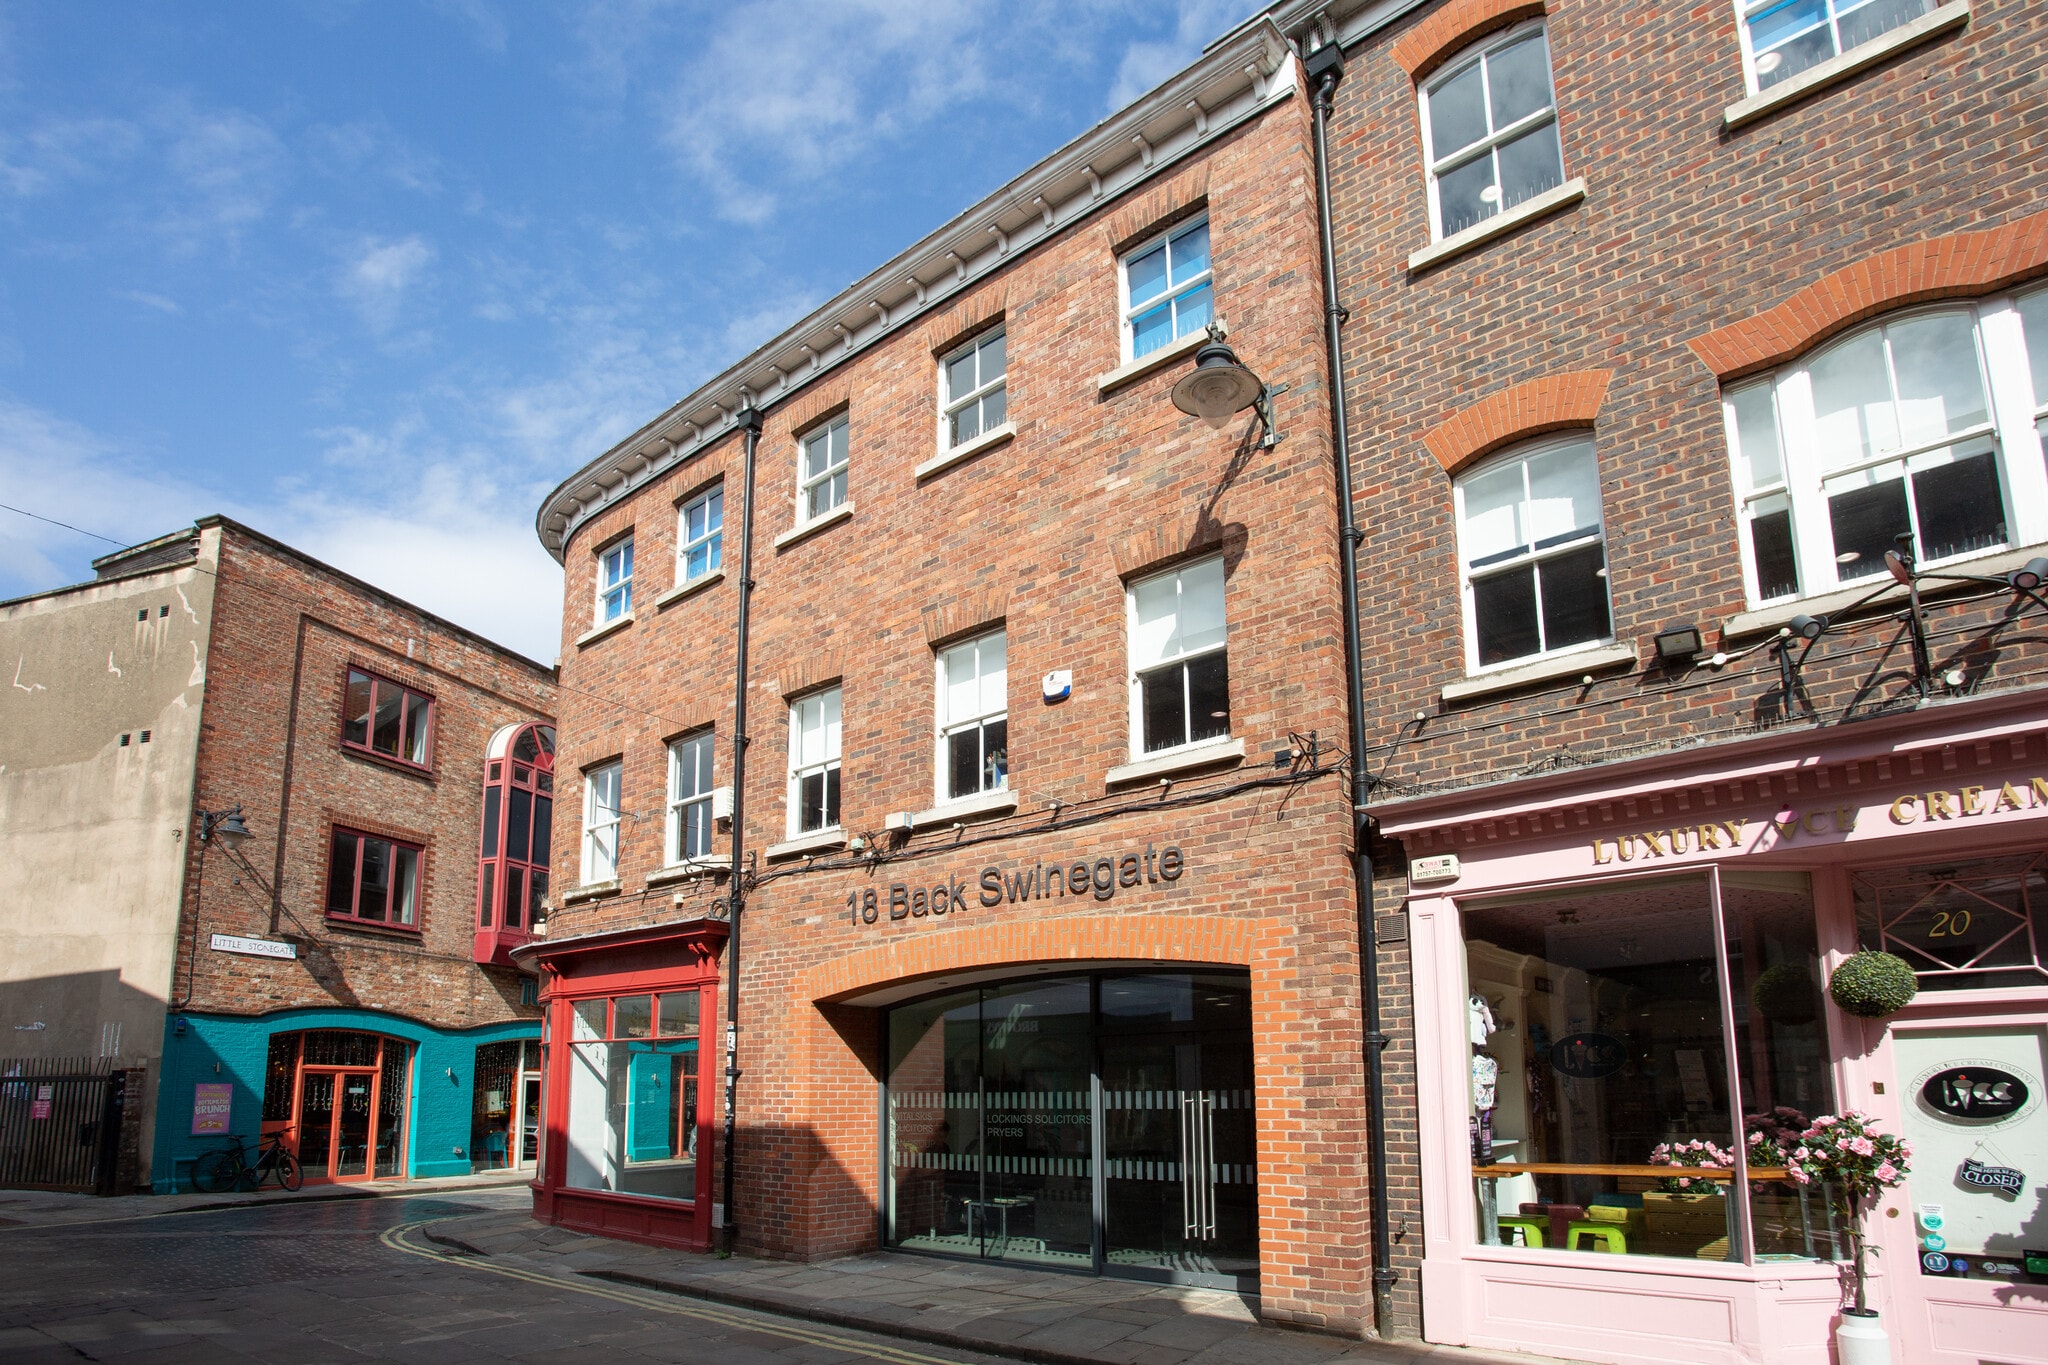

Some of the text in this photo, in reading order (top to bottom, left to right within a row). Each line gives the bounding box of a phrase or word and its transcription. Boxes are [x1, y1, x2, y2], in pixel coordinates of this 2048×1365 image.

[1592, 817, 1749, 866] LUXURY
[847, 841, 1185, 926] 18 Back Swinegate
[1929, 909, 1972, 938] 20
[214, 938, 294, 955] LITTLE STONEGATE
[195, 1104, 230, 1115] BRUNCH
[986, 1114, 1092, 1125] LOCKINGS SOLICITORS
[986, 1127, 1024, 1137] PRYERS
[1965, 1170, 2019, 1187] CLOSED
